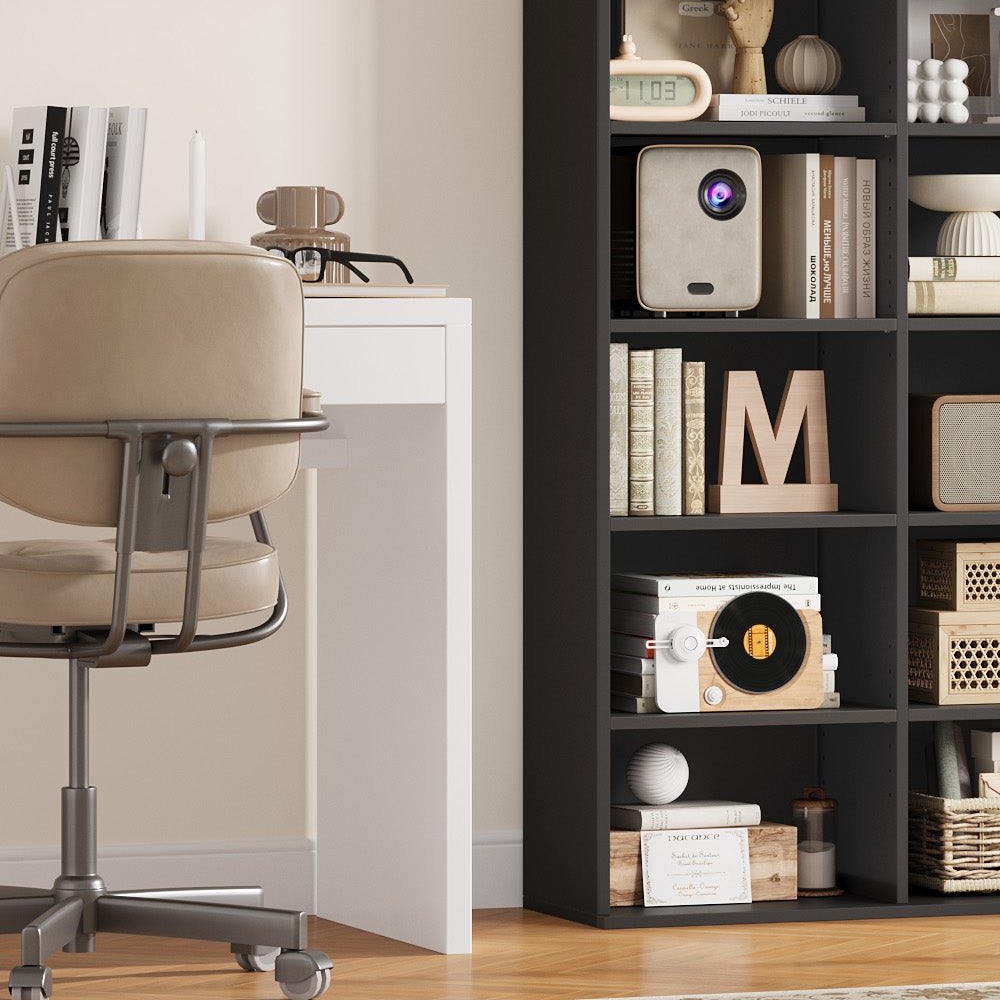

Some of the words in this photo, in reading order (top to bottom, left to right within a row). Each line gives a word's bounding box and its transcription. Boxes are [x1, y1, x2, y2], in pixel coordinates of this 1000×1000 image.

[682, 4, 709, 13] Greek
[863, 180, 871, 219] НОВЫЙ
[863, 222, 871, 256] ОБРАЗ
[823, 272, 832, 303] ЛУЧШЕ
[863, 260, 871, 298] ЖИЗНИ
[718, 370, 831, 484] M
[729, 583, 781, 592] Impressionists
